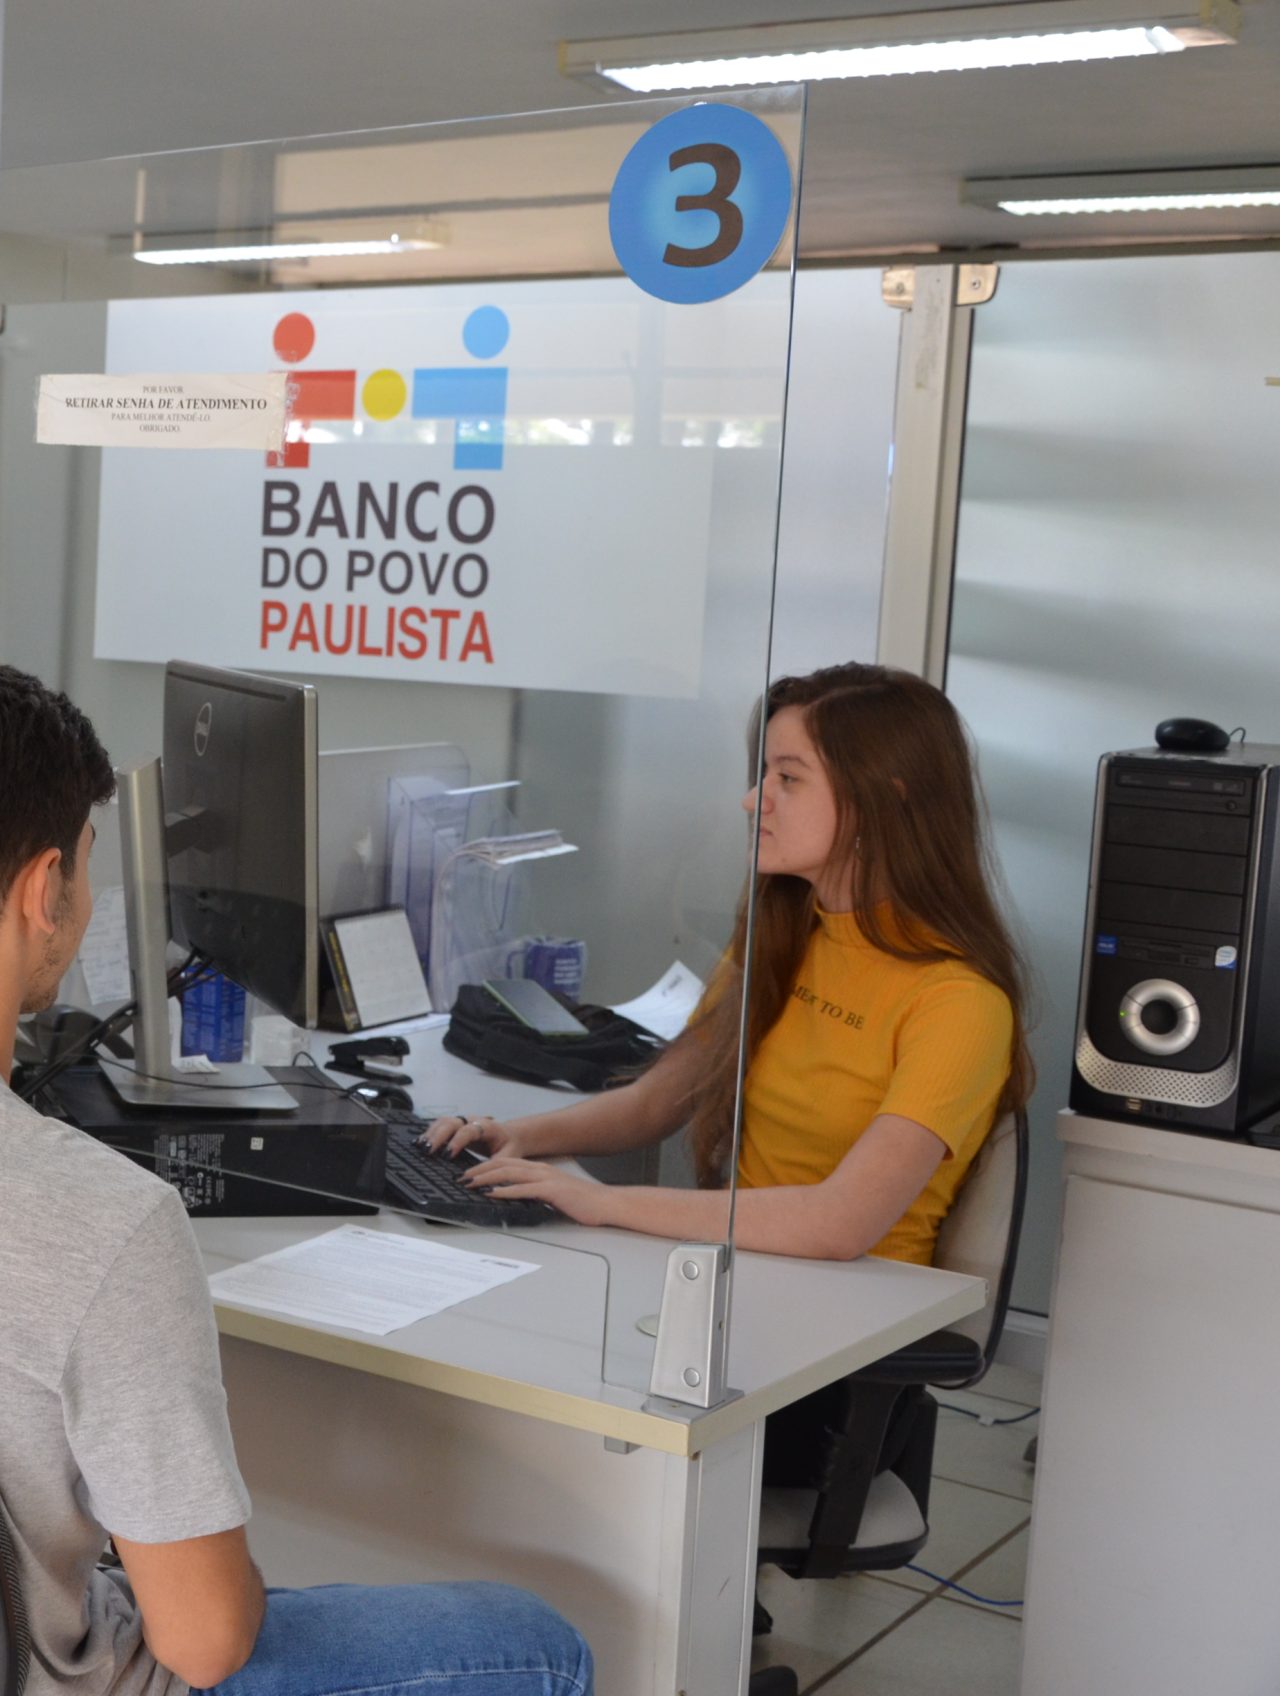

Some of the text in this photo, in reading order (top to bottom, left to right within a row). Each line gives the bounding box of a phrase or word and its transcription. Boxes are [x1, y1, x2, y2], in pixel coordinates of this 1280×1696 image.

[662, 143, 744, 268] 3
[65, 397, 268, 410] RETIRAR SENHA DE ATENDIMENTO
[142, 385, 184, 394] POR FAVOR
[111, 412, 131, 421] PARA
[133, 413, 164, 421] MELHOR
[261, 480, 495, 545] BANCO
[261, 547, 489, 599] DO POVO
[260, 600, 494, 664] PAULISTA
[820, 1001, 842, 1018] TO
[844, 1011, 865, 1030] BE
